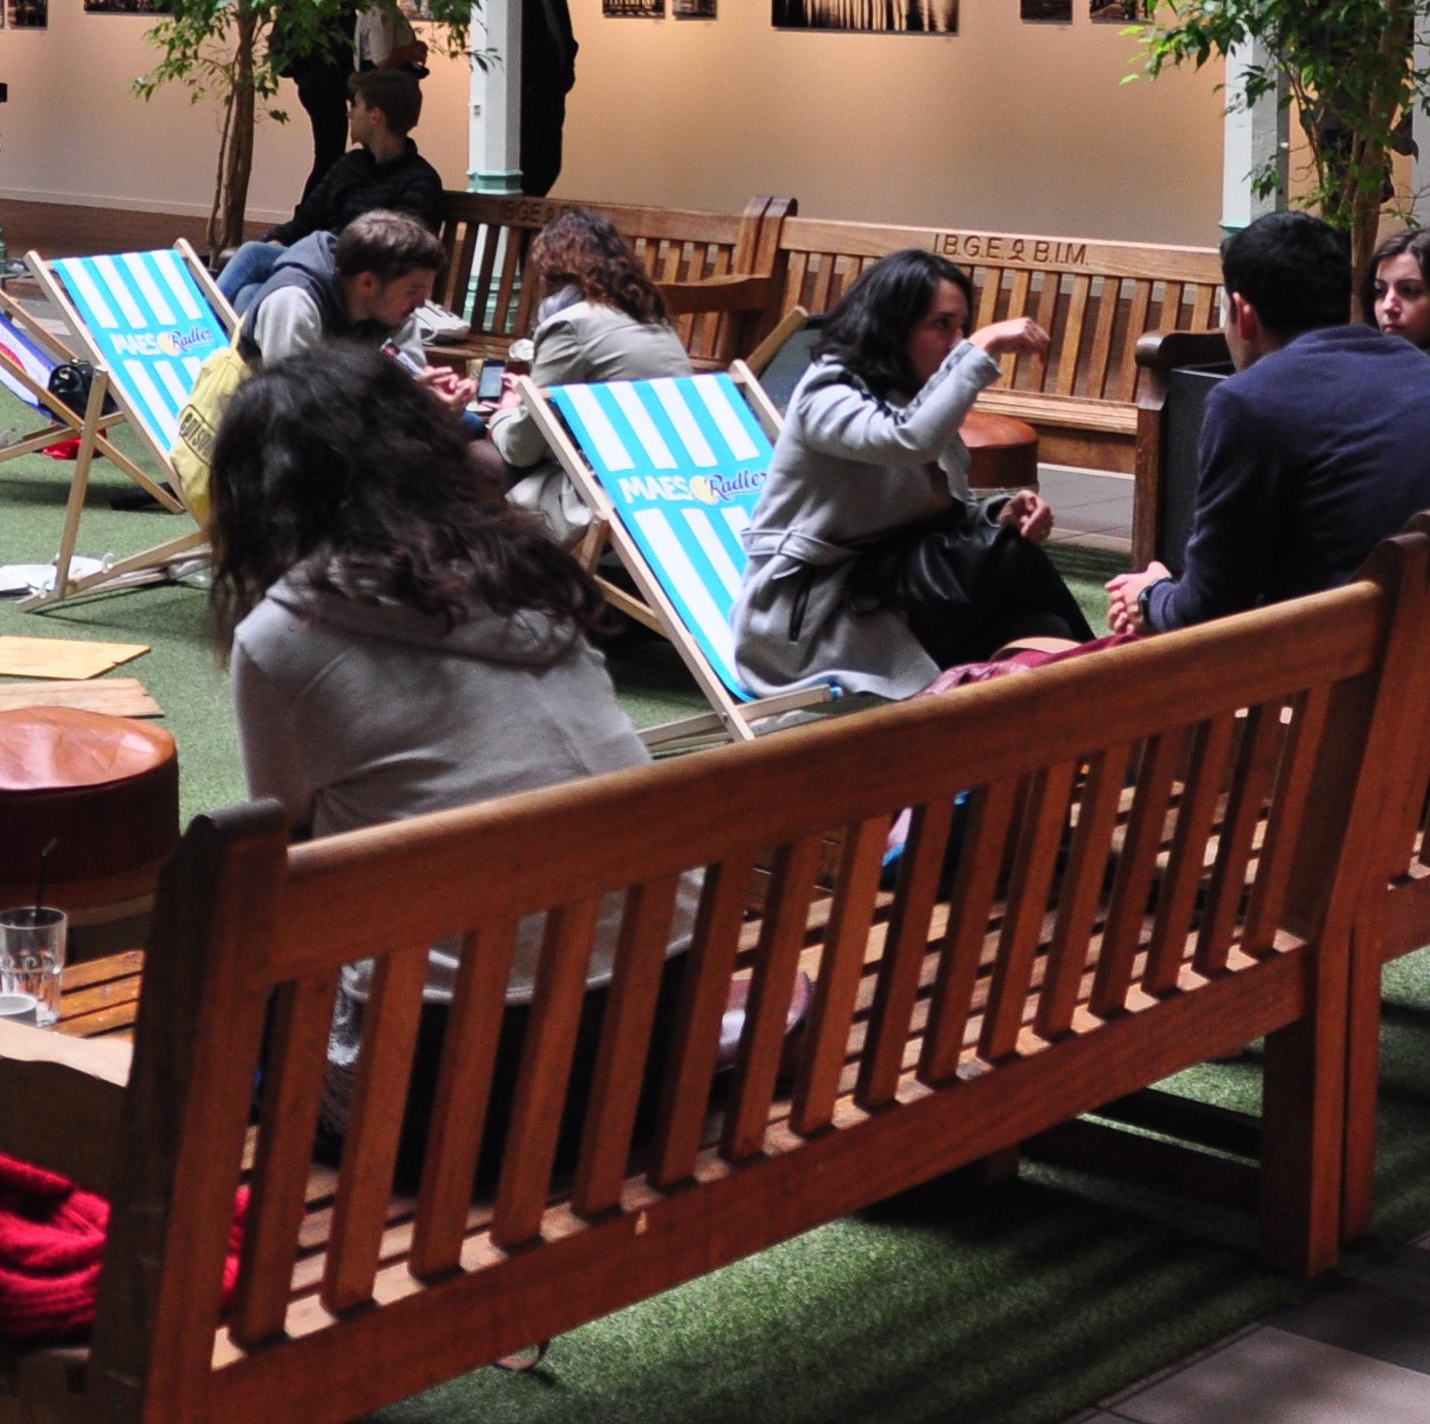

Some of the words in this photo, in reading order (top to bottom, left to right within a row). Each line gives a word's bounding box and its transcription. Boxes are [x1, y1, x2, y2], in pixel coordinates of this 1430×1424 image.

[109, 332, 162, 355] MAES
[170, 327, 212, 353] Radler
[618, 476, 695, 504] MAES
